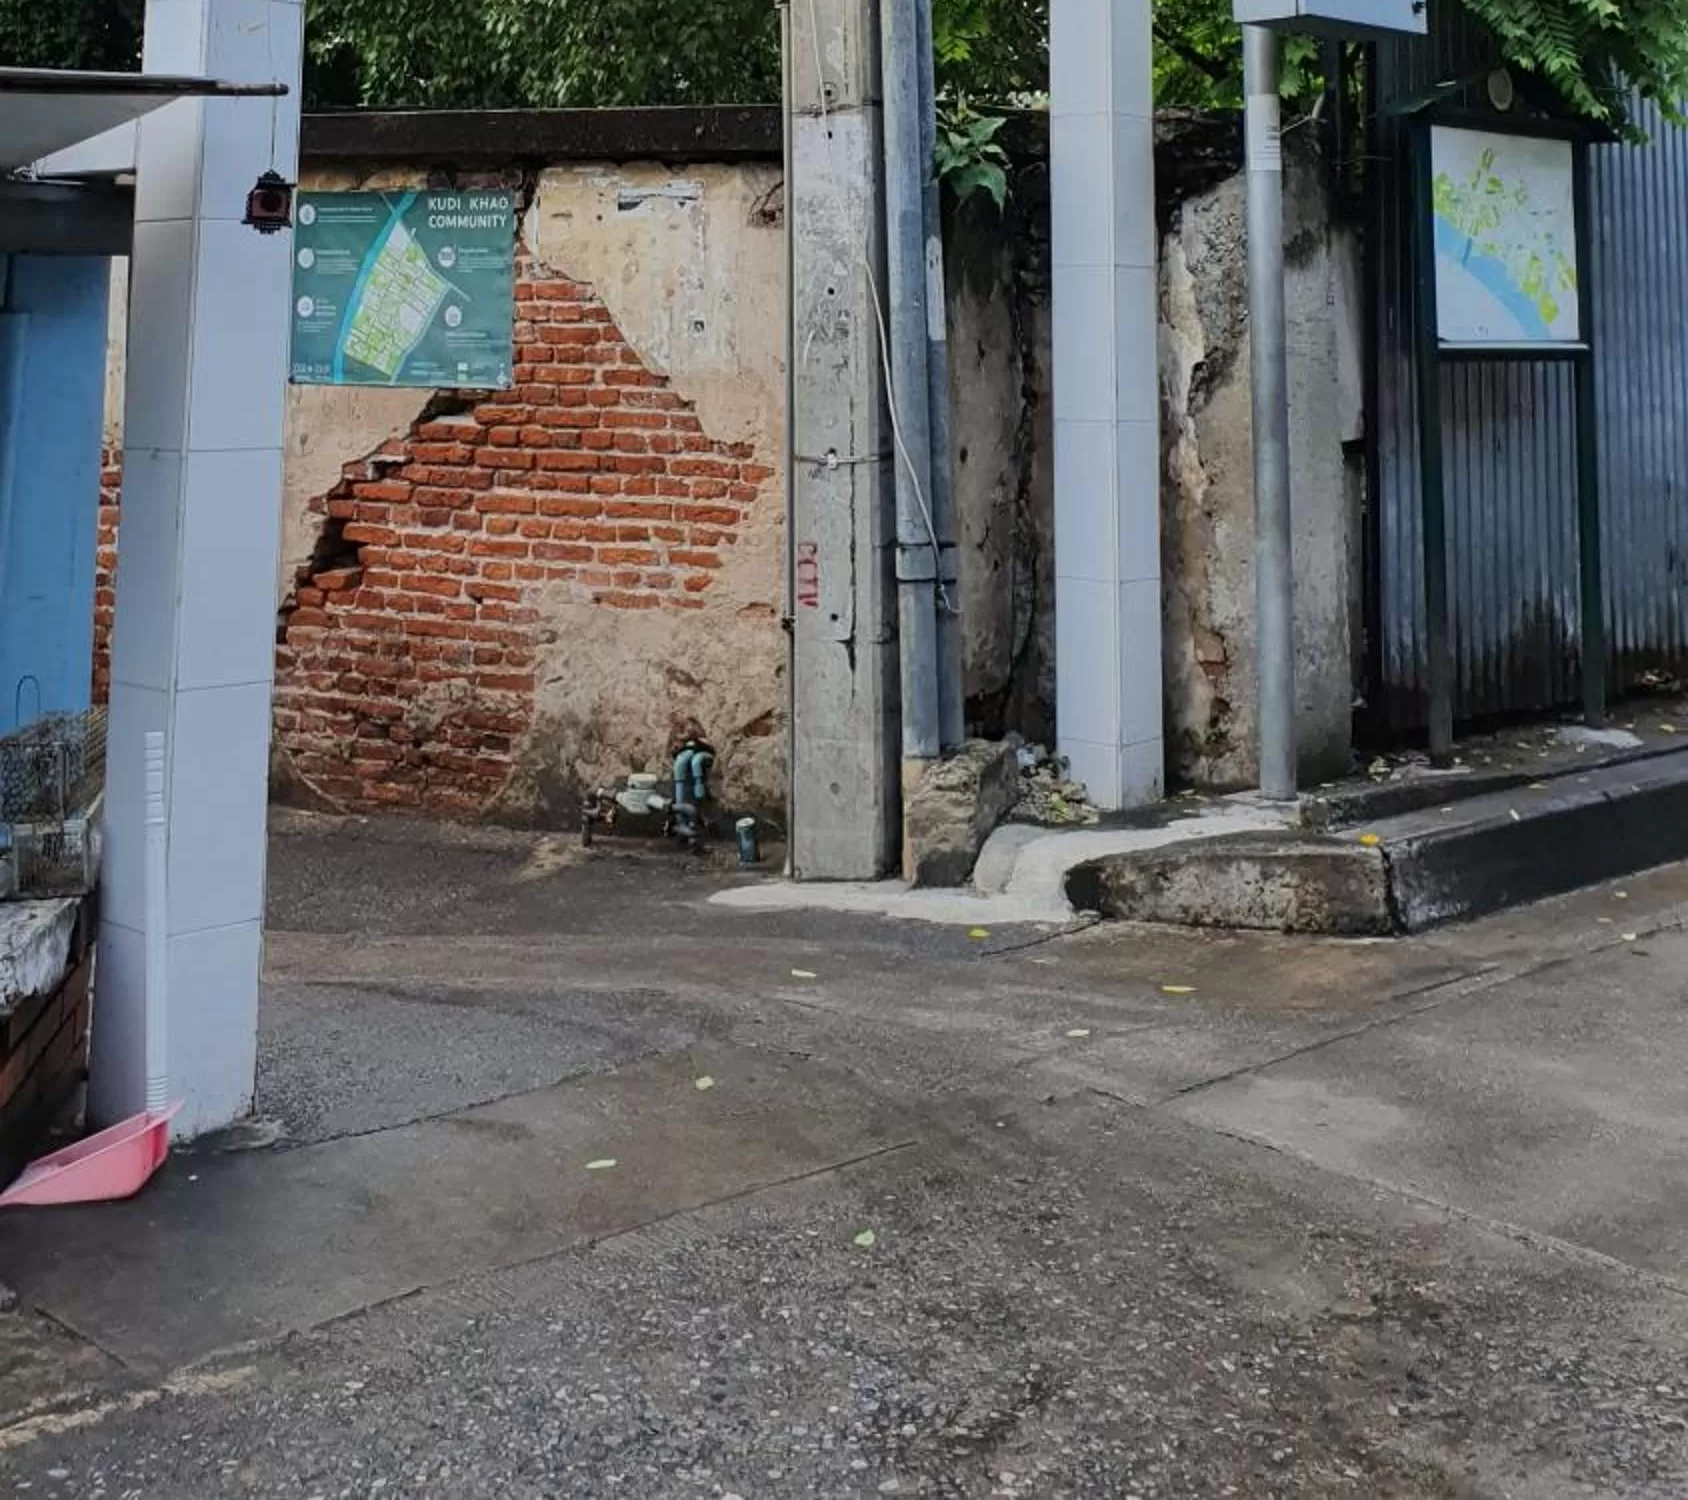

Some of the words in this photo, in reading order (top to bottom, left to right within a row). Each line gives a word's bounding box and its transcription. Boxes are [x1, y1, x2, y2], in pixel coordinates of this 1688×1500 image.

[427, 196, 461, 211] KUDI
[468, 195, 509, 210] KHAO
[427, 214, 508, 229] COMMUNITY
[797, 542, 819, 609] CCTV
